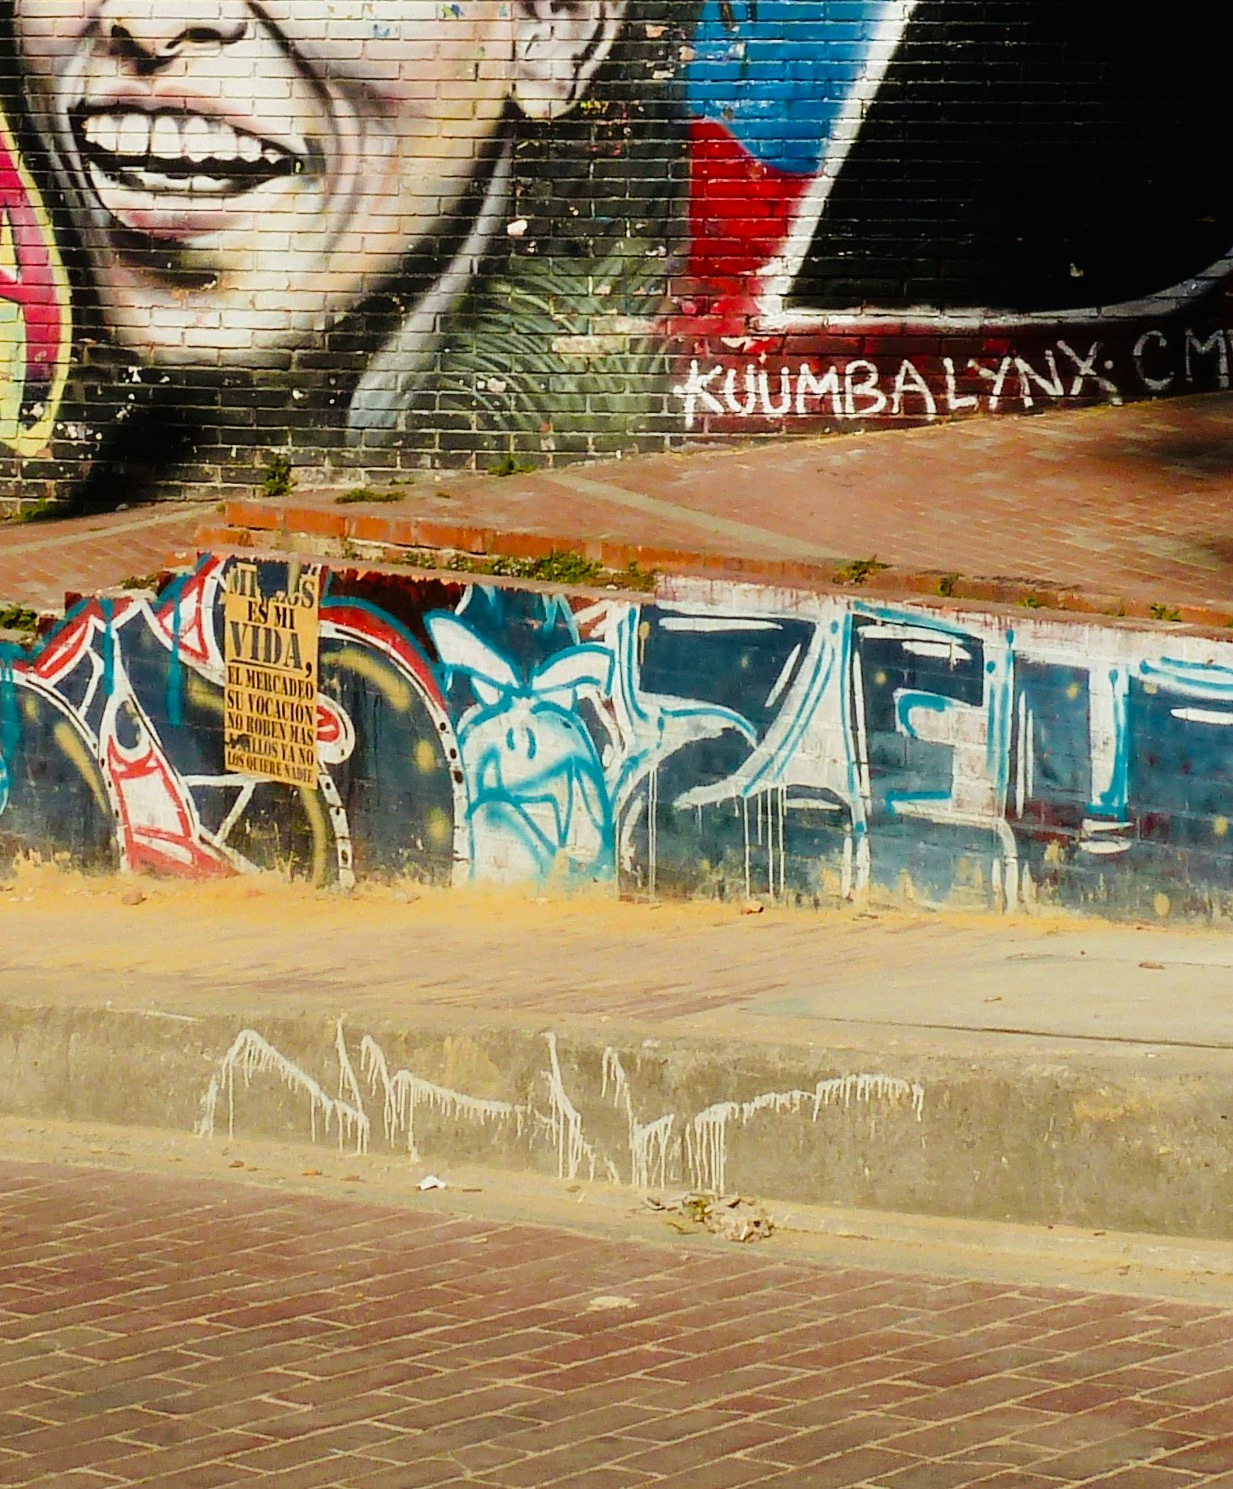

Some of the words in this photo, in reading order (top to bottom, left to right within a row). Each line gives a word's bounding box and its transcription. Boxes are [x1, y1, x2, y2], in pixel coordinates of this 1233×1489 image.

[1132, 328, 1233, 390] CM
[248, 600, 268, 624] ES
[274, 605, 294, 630] MI
[229, 620, 312, 678] VIDA,
[227, 689, 243, 711] SU
[228, 665, 243, 686] EL
[245, 668, 314, 701] MERCADEO
[227, 711, 243, 730] NO
[246, 715, 287, 741] ROBEN
[290, 723, 315, 747] MAS
[228, 750, 245, 768] LOS
[246, 754, 283, 777] QUIERE
[284, 763, 314, 784] NADIE
[280, 742, 295, 763] YA
[298, 746, 314, 767] NO
